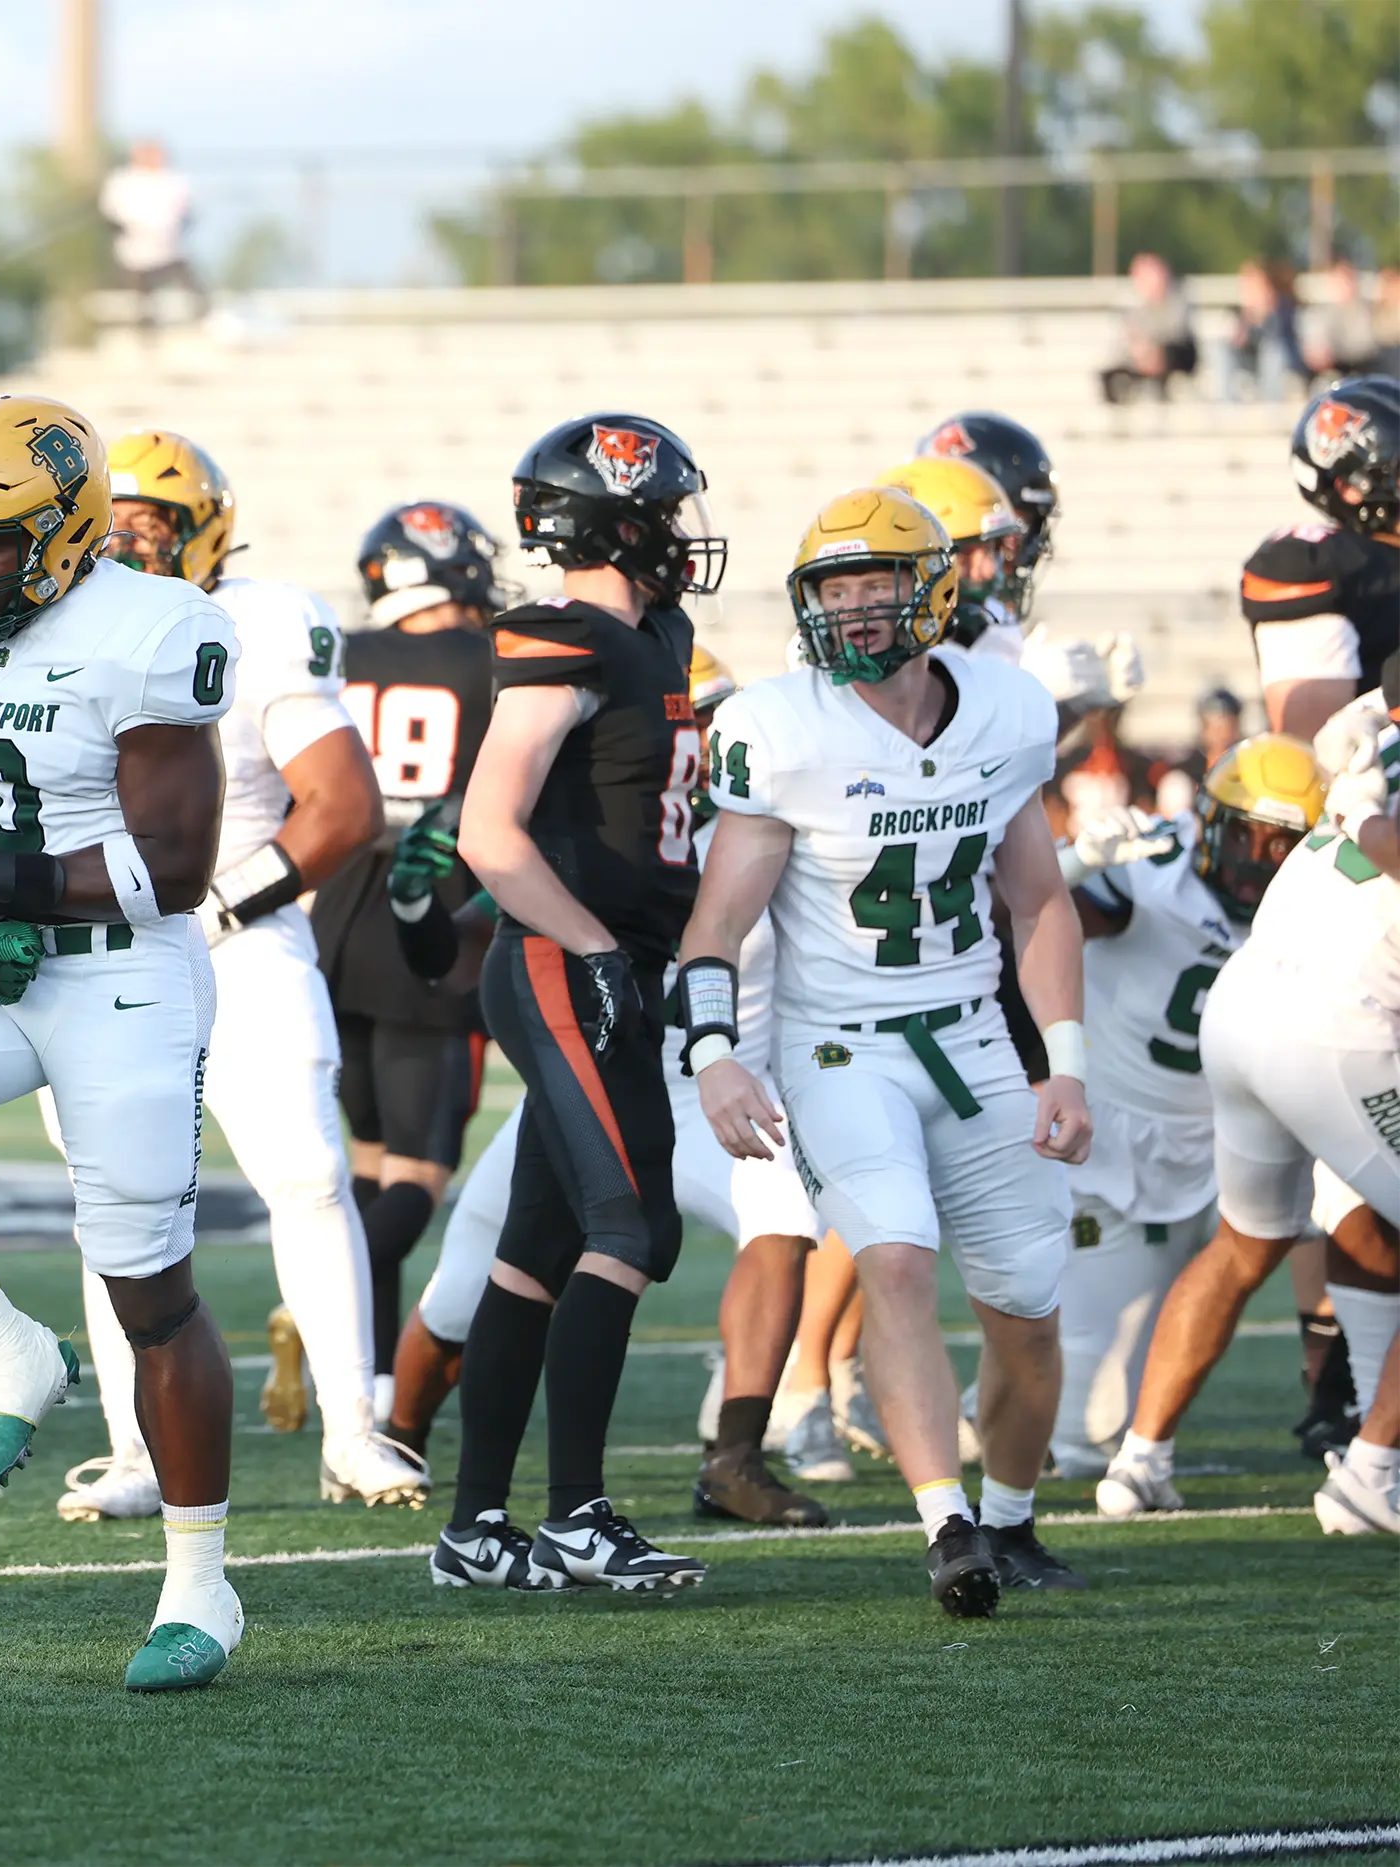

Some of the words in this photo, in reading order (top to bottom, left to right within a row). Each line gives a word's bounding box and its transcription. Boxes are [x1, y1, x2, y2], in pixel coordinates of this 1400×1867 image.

[25, 424, 89, 494] B
[193, 642, 228, 706] 0
[868, 799, 990, 838] BROCKPORT
[849, 831, 990, 968] 44
